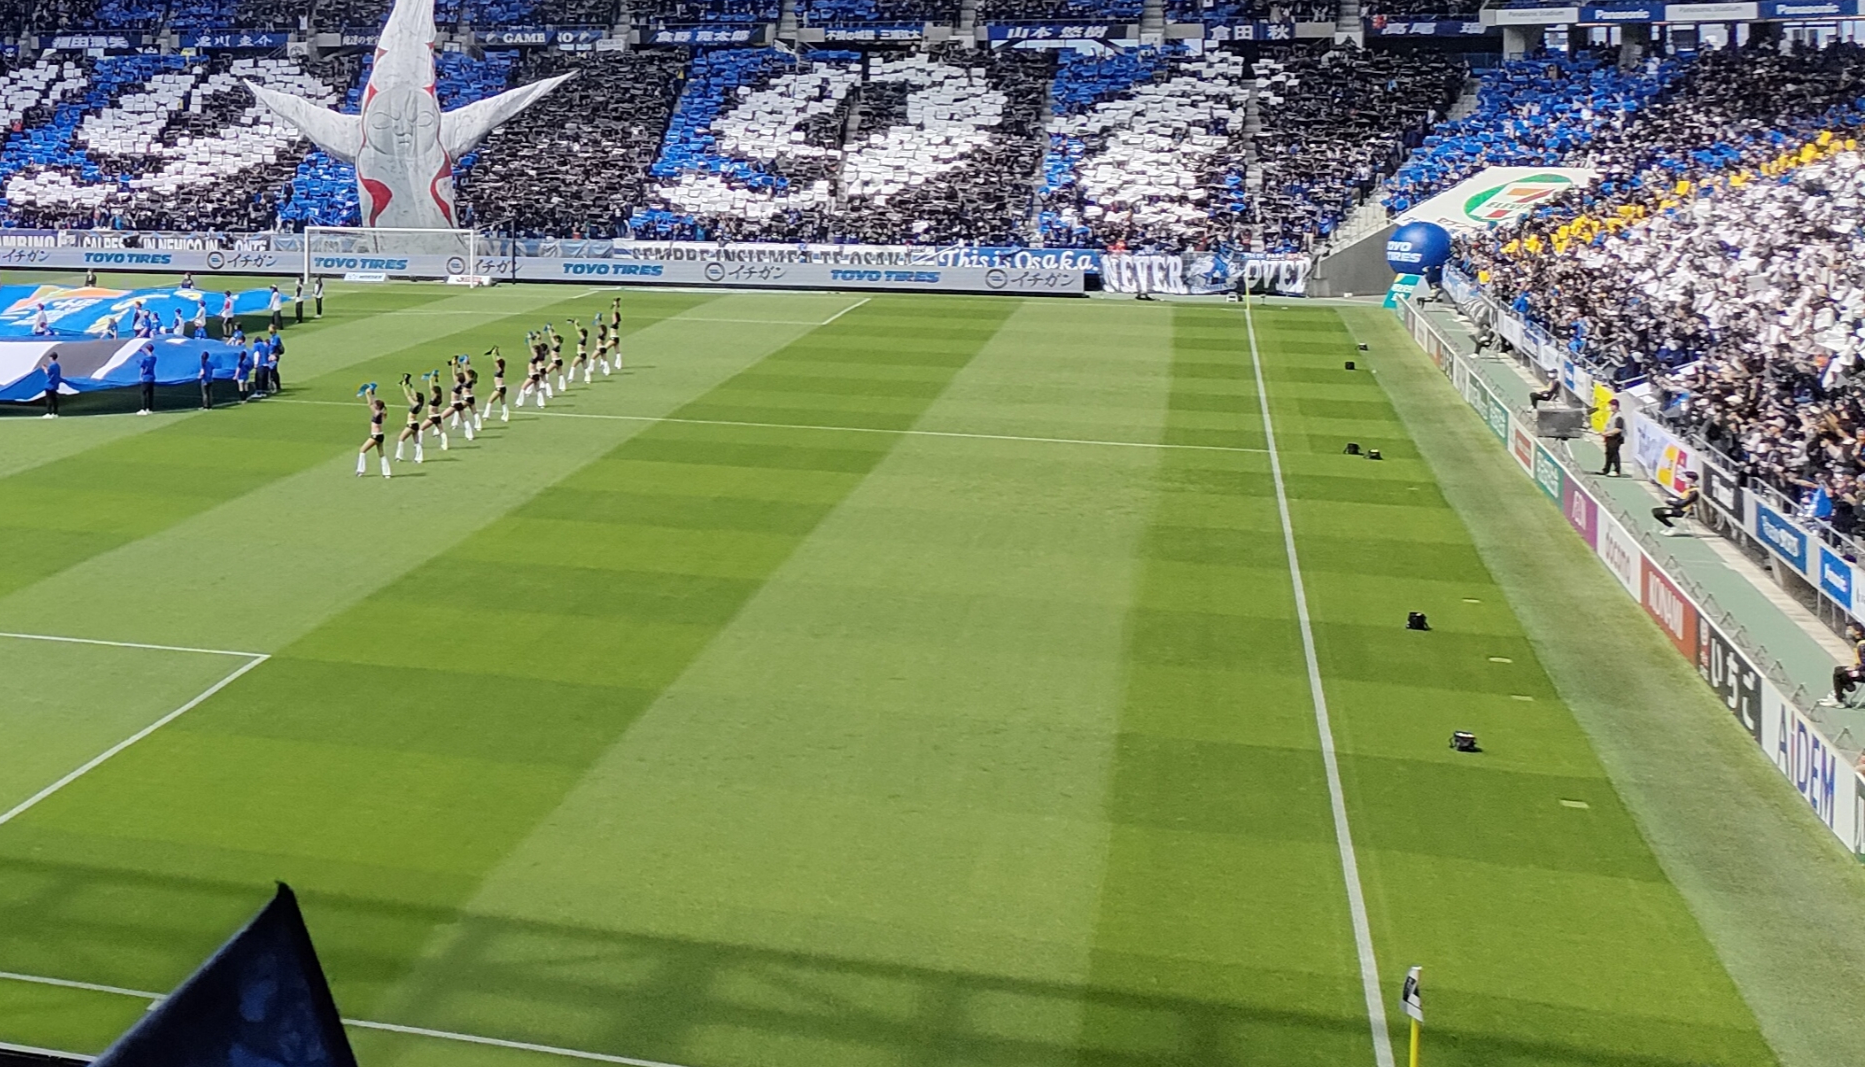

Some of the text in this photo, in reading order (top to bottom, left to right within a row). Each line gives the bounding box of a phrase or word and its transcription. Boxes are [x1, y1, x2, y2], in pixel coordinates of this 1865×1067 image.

[1594, 9, 1650, 20] Panasonic
[1776, 2, 1840, 15] Panasonic
[1210, 24, 1289, 40] 倉田 秋
[1387, 240, 1411, 252] OYO
[127, 252, 172, 265] TIRES
[359, 258, 407, 271] TIRES
[938, 248, 990, 268] This
[612, 264, 664, 277] TIRES
[882, 270, 941, 283] TIRES
[1101, 254, 1311, 295] NEVER OVER
[1648, 570, 1684, 641] KONAMI
[1711, 638, 1756, 731] いちご
[1777, 703, 1837, 829] AiDEM
